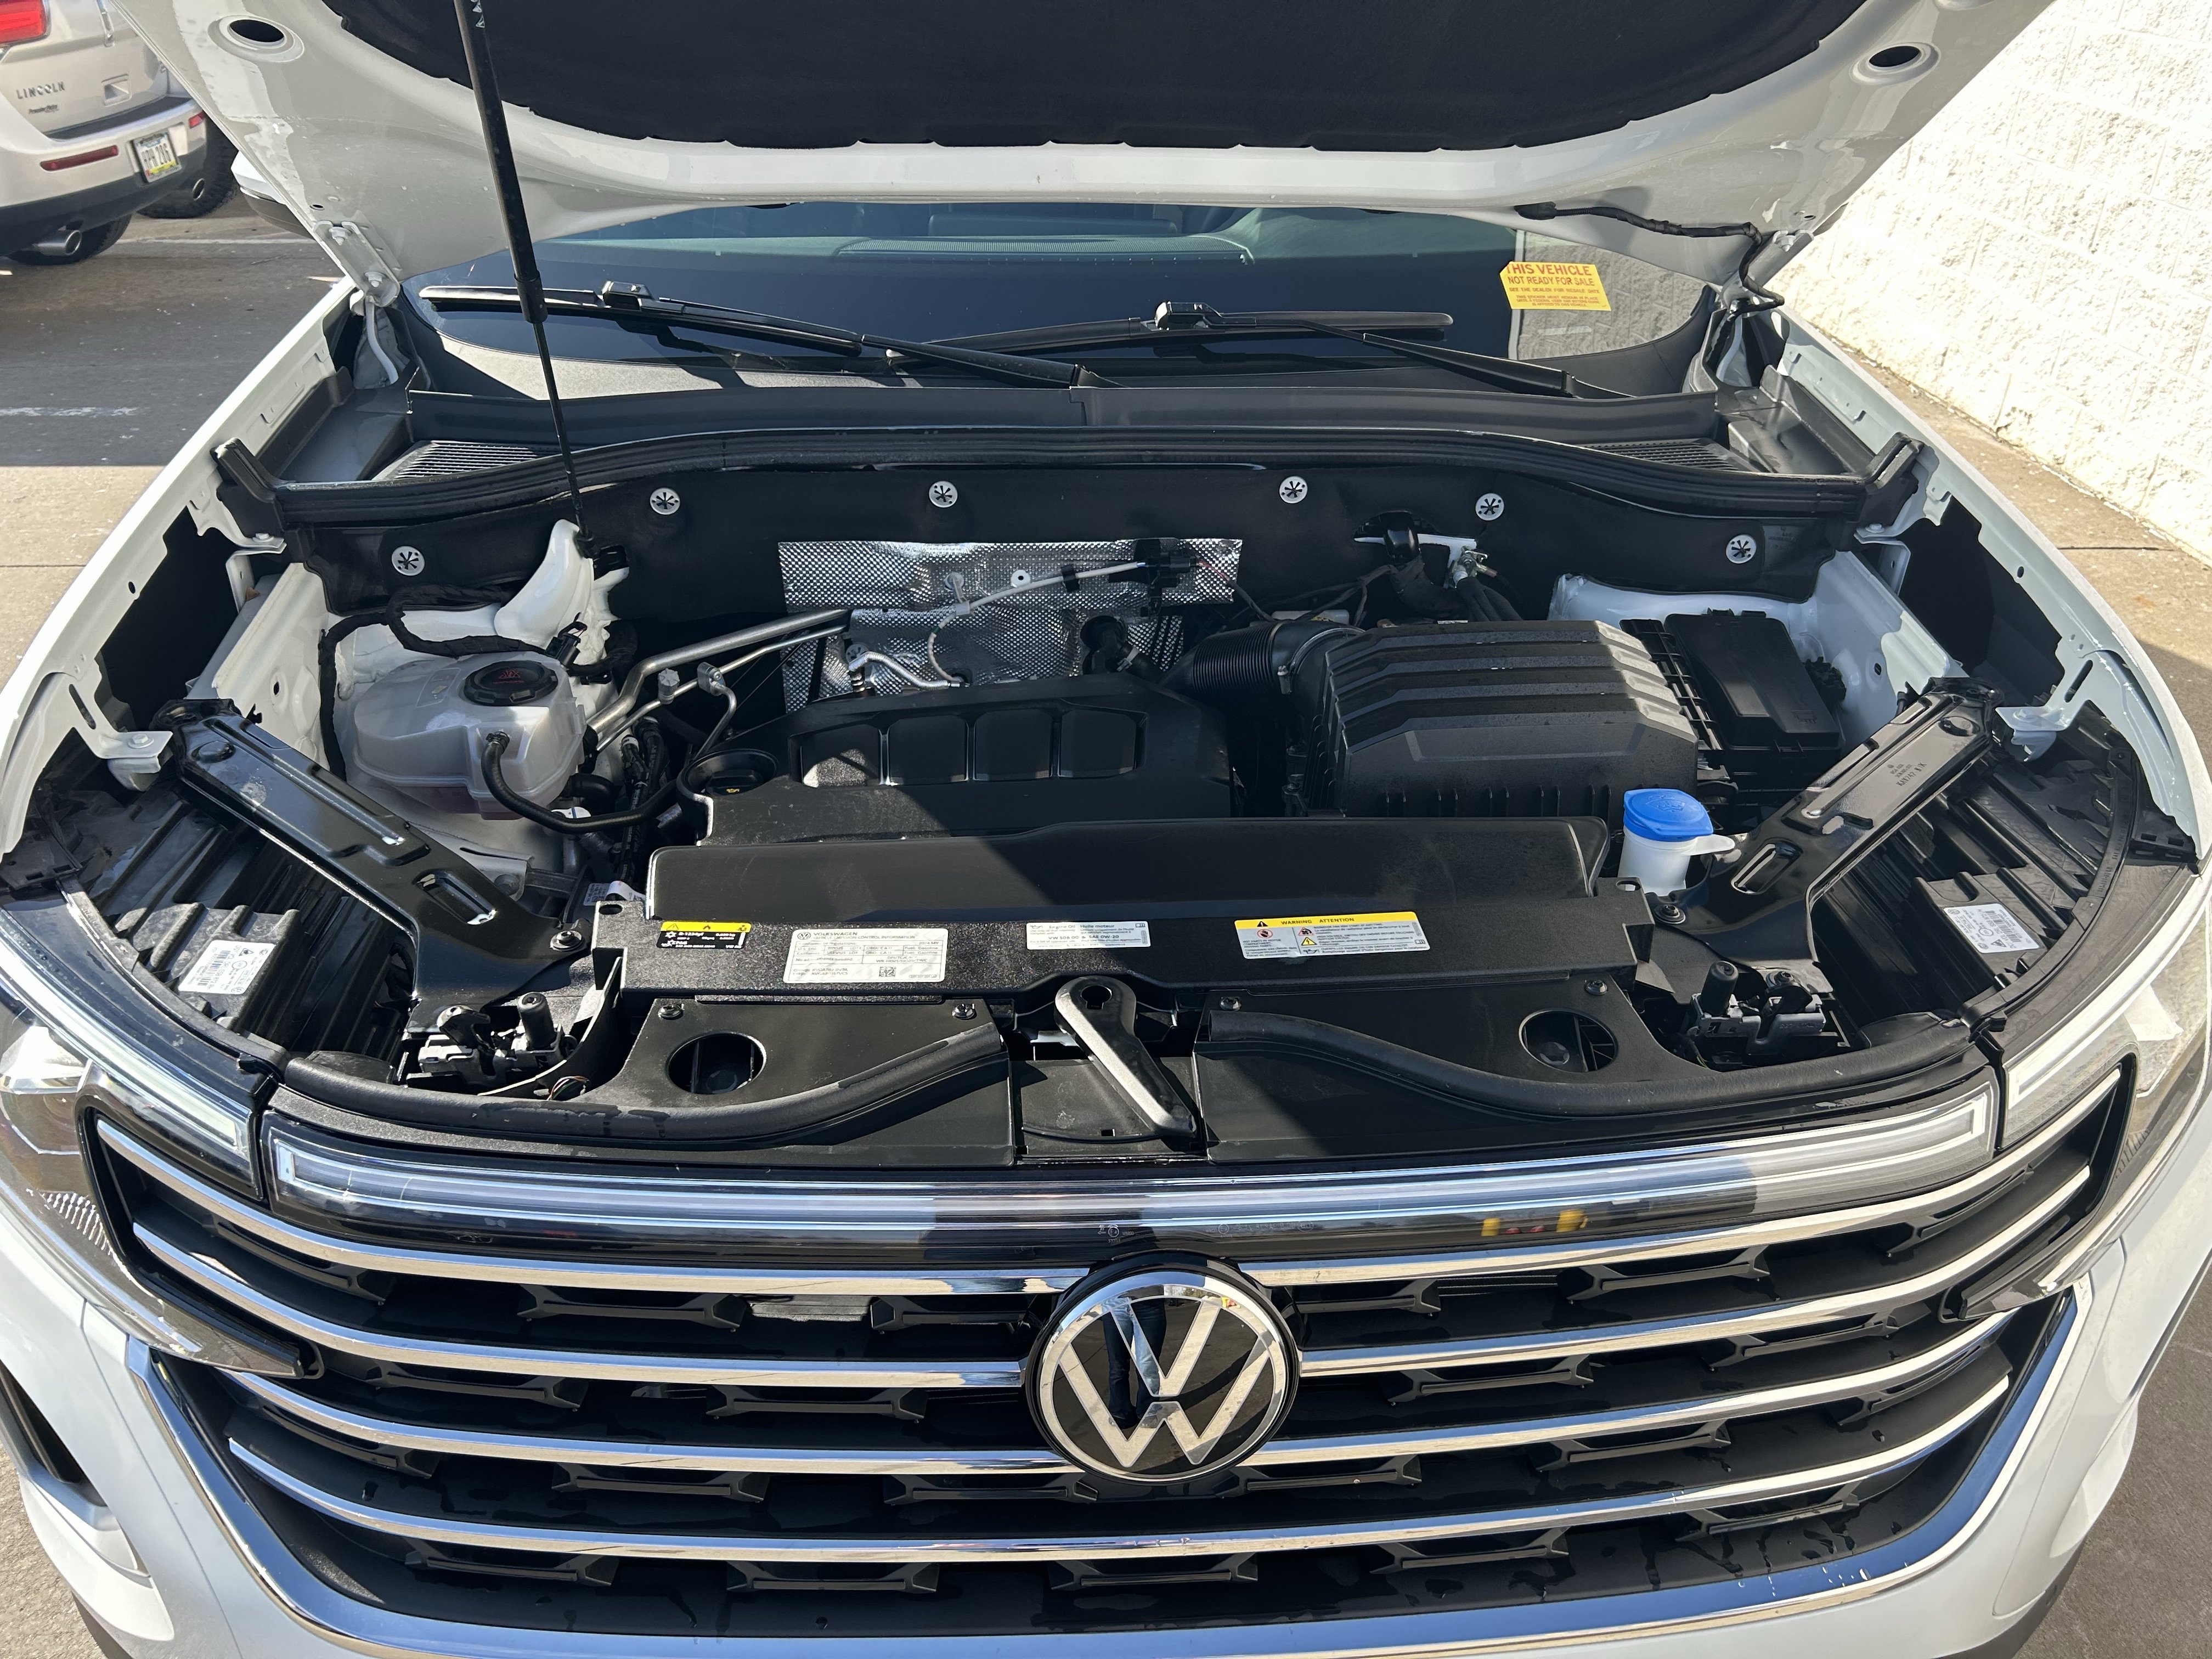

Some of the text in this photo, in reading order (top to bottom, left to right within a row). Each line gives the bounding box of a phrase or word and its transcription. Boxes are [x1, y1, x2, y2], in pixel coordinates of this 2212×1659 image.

[16, 81, 65, 99] LINCOLN
[1506, 264, 1592, 275] THIS VEHICLE
[1527, 276, 1554, 285] READY
[1556, 277, 1572, 285] FOR
[1575, 278, 1594, 286] SALE
